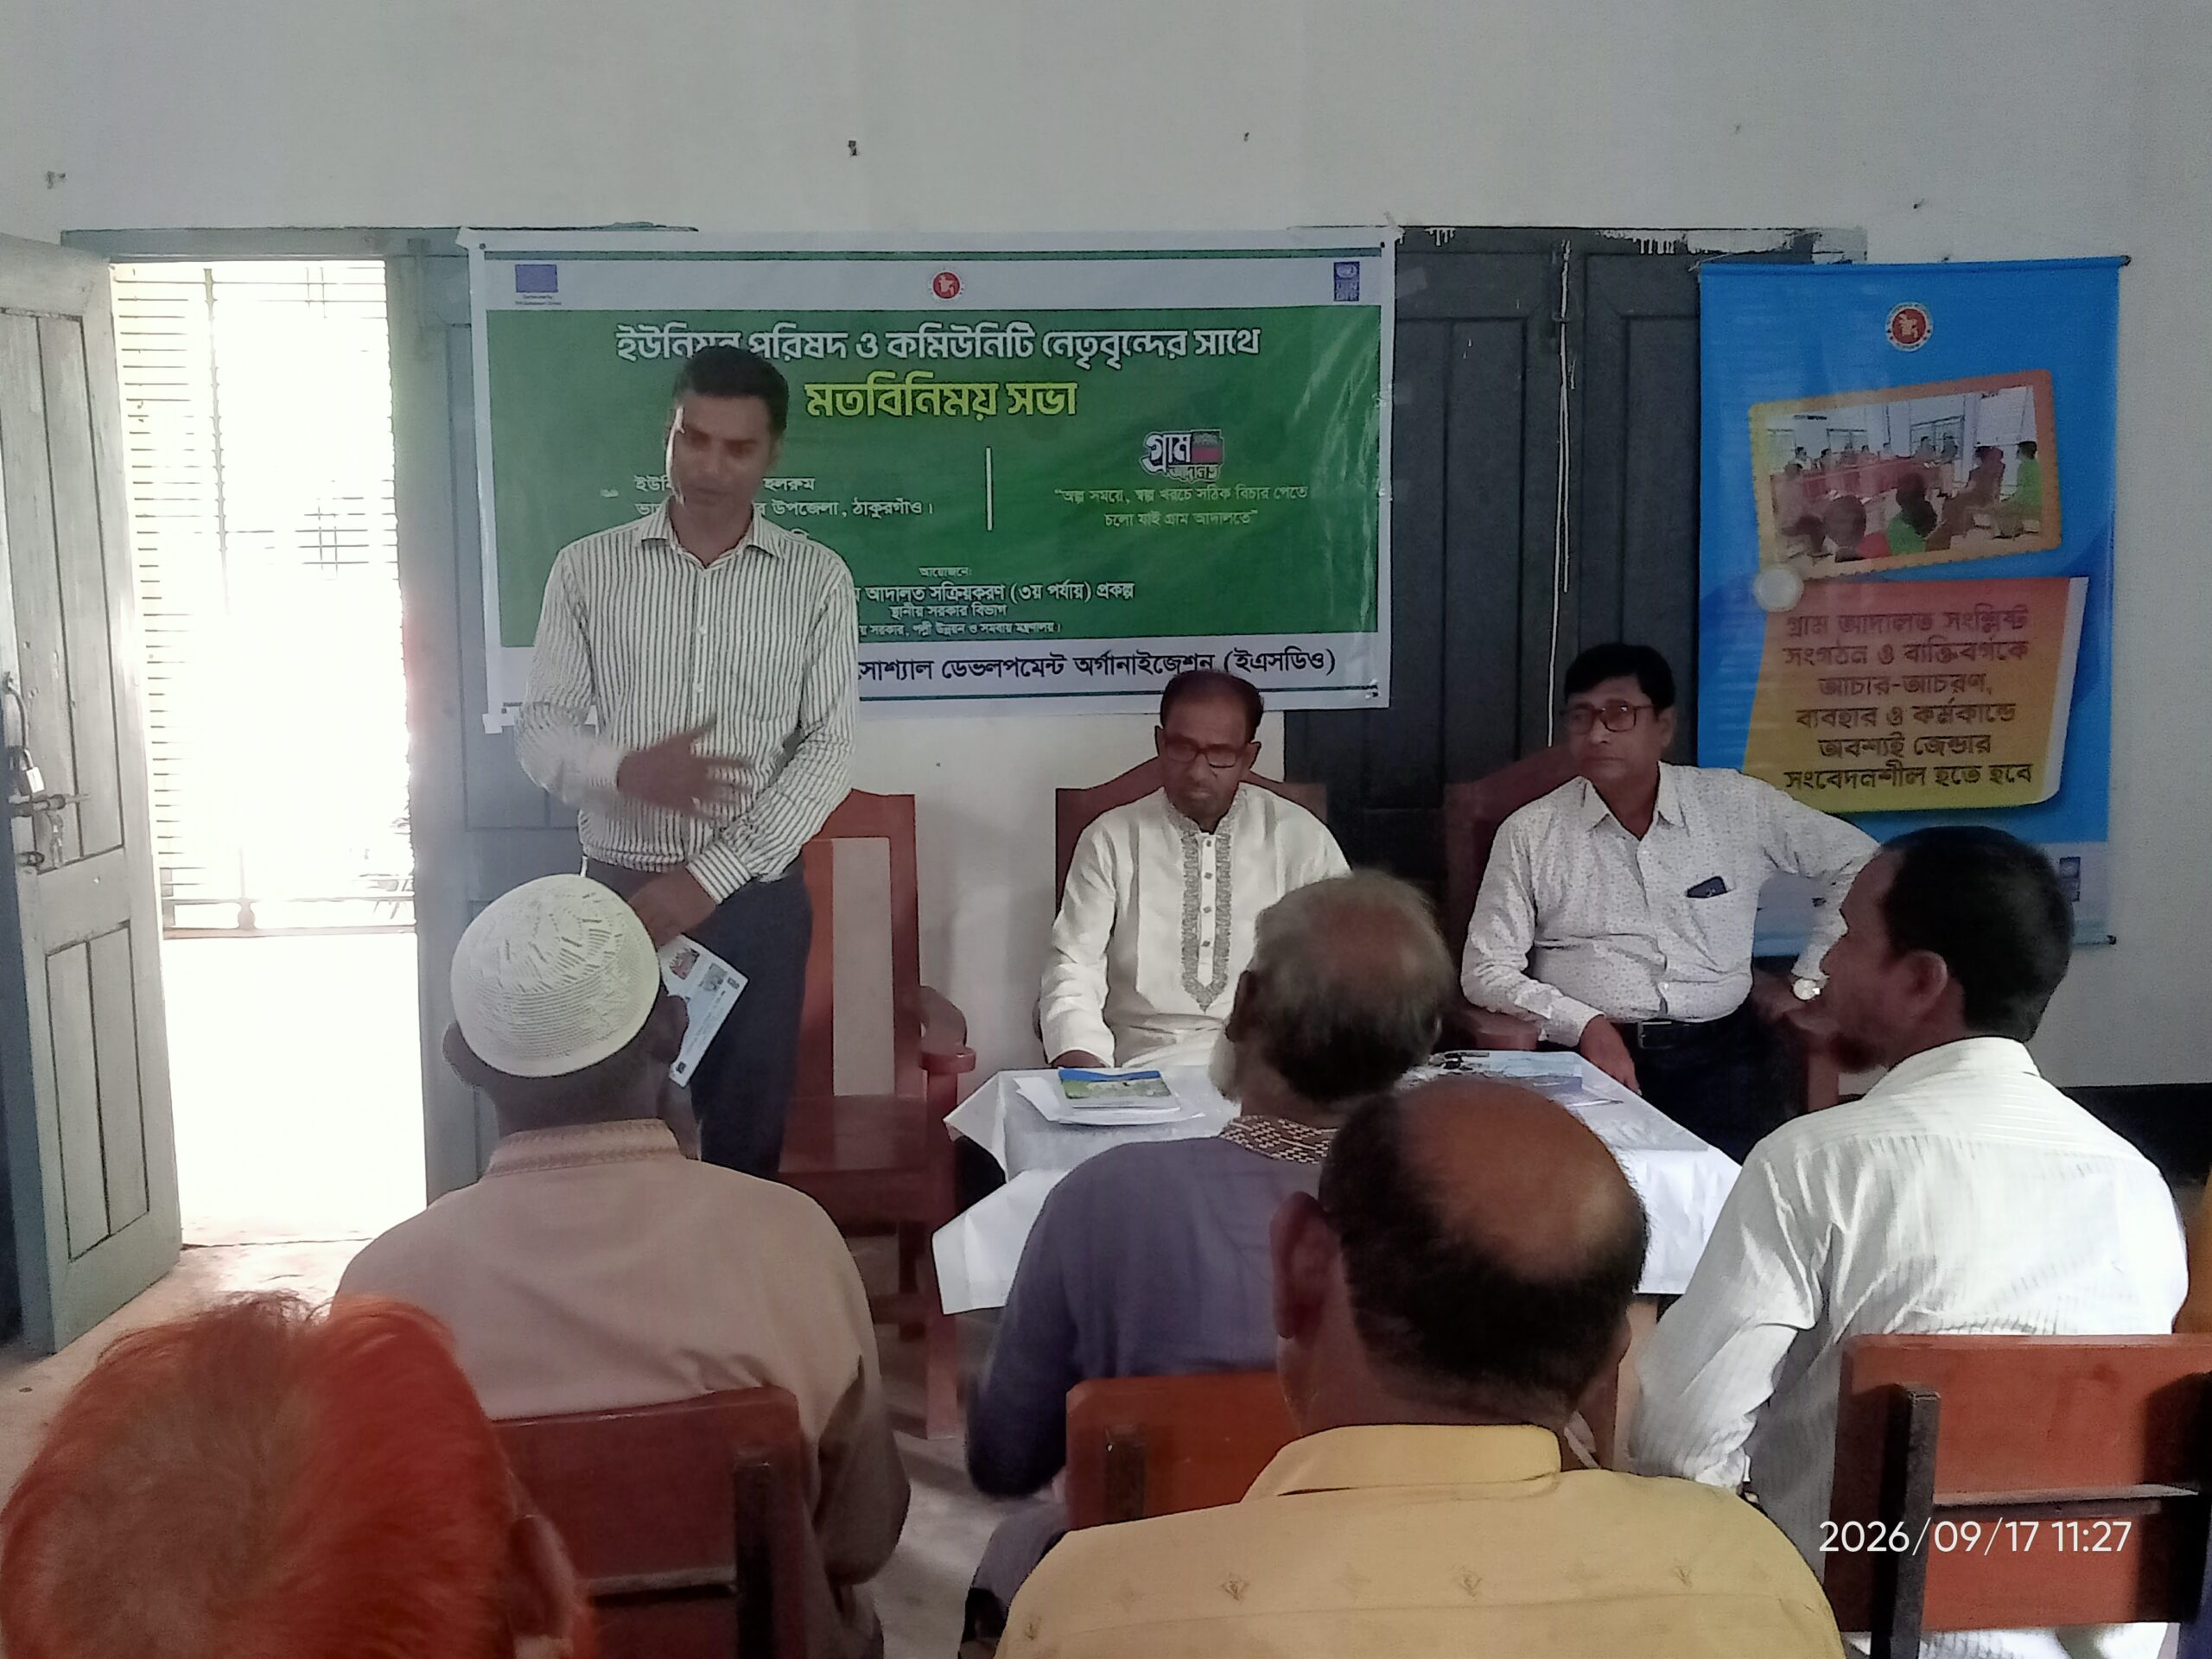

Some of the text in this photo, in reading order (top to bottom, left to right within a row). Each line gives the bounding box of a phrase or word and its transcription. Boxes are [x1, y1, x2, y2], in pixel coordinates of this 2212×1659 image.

[747, 321, 849, 362] পরিষদ
[855, 332, 879, 359] ও
[885, 321, 1035, 359] কমিউনিটি
[1042, 330, 1188, 370] নেতৃবৃন্দের
[1193, 327, 1261, 355] সাথে
[804, 370, 1078, 422] মতবিনিময় সভা
[763, 477, 816, 492] হলরুম
[1234, 482, 1269, 501] বিচার
[864, 585, 927, 603] আদালত
[928, 581, 1006, 602] সক্রিয়করণ
[1096, 582, 1135, 600] প্রকল্প
[927, 605, 969, 618] সরকার
[971, 601, 1008, 618] বিভাগ
[1786, 614, 1829, 638] গ্রাম
[1836, 612, 1936, 634] আদালত
[941, 652, 1068, 680] ডেভলপমেন্ট
[1072, 649, 1216, 676] অর্গানাইজেশন
[1223, 645, 1336, 677] (ইএসডিও)
[1781, 638, 1867, 666] সংগঠন
[1877, 644, 1895, 665] ও
[1885, 706, 1904, 727] ও
[1817, 731, 1992, 758] অবশ্যই জেন্ডার
[1783, 759, 2034, 791] সংবেদনশীল হতে হবে
